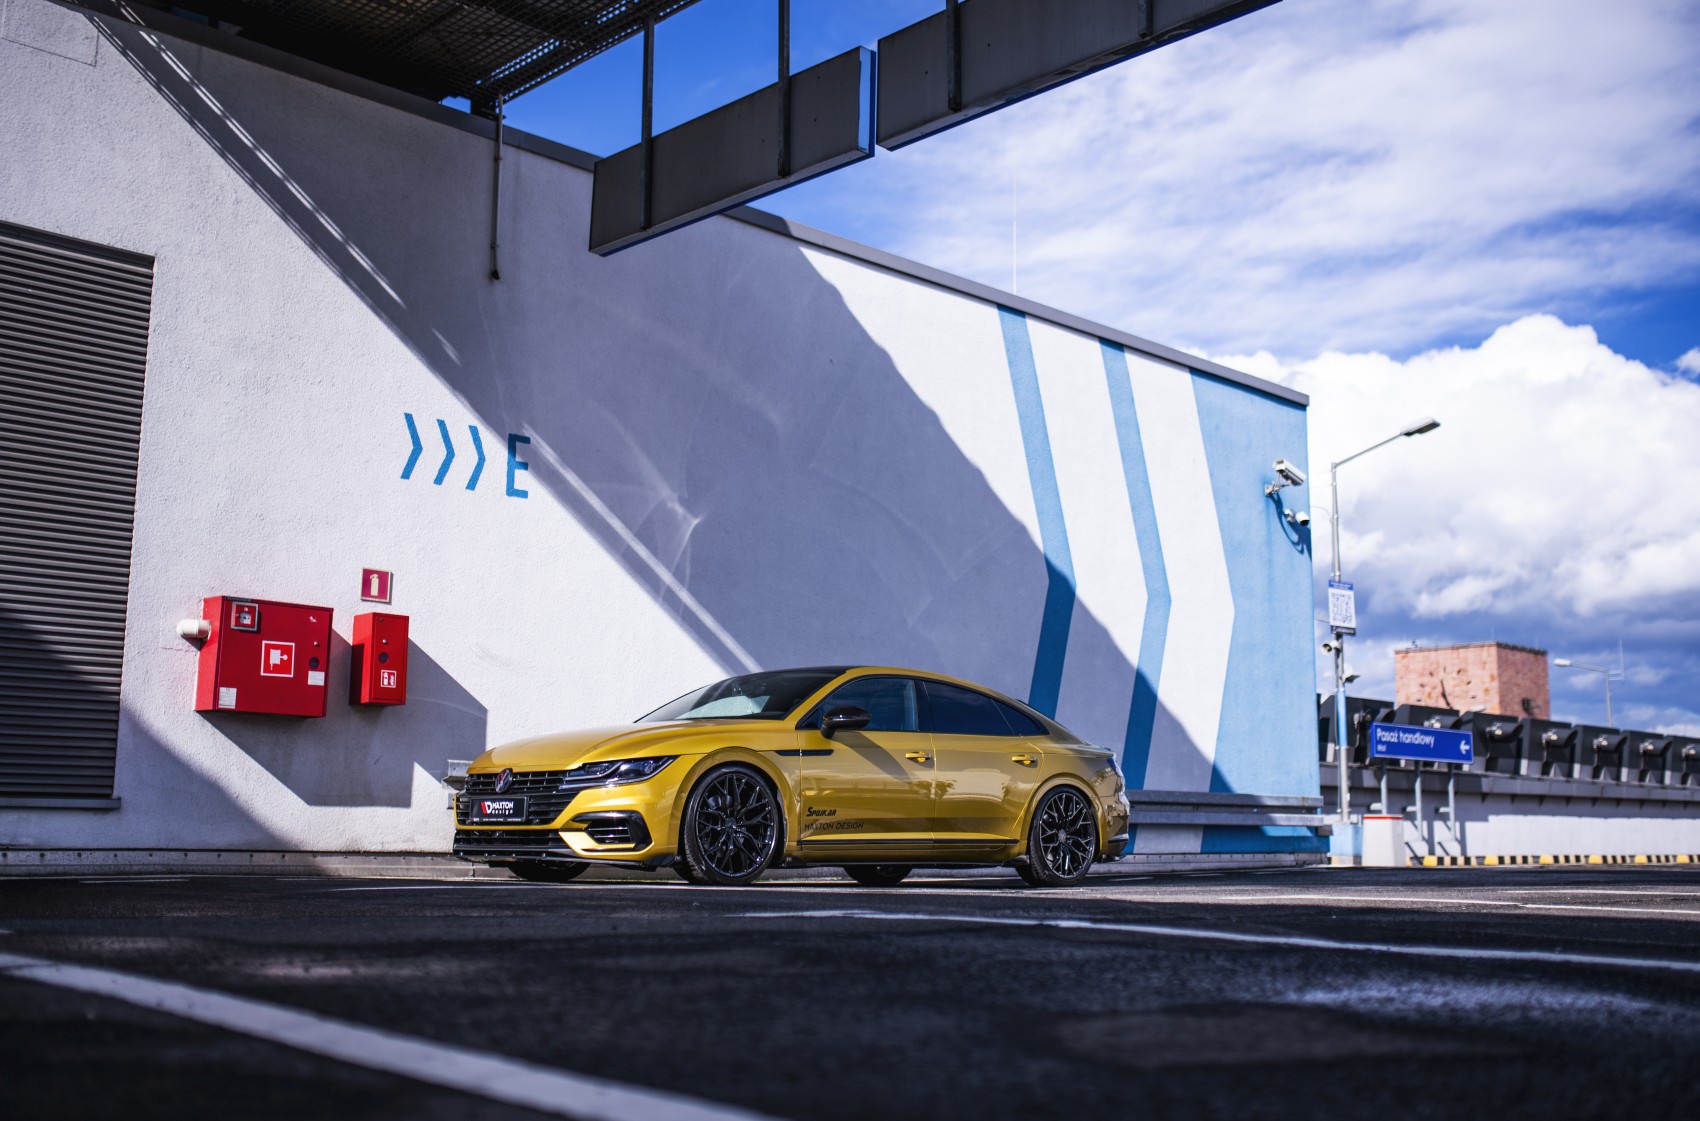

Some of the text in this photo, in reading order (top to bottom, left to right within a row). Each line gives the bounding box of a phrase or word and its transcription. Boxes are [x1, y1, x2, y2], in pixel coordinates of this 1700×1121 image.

[506, 433, 531, 498] E
[1376, 728, 1435, 748] Pasaż handlowy
[492, 801, 514, 810] MAXTON
[804, 821, 864, 831] MAXTON DESIGN
